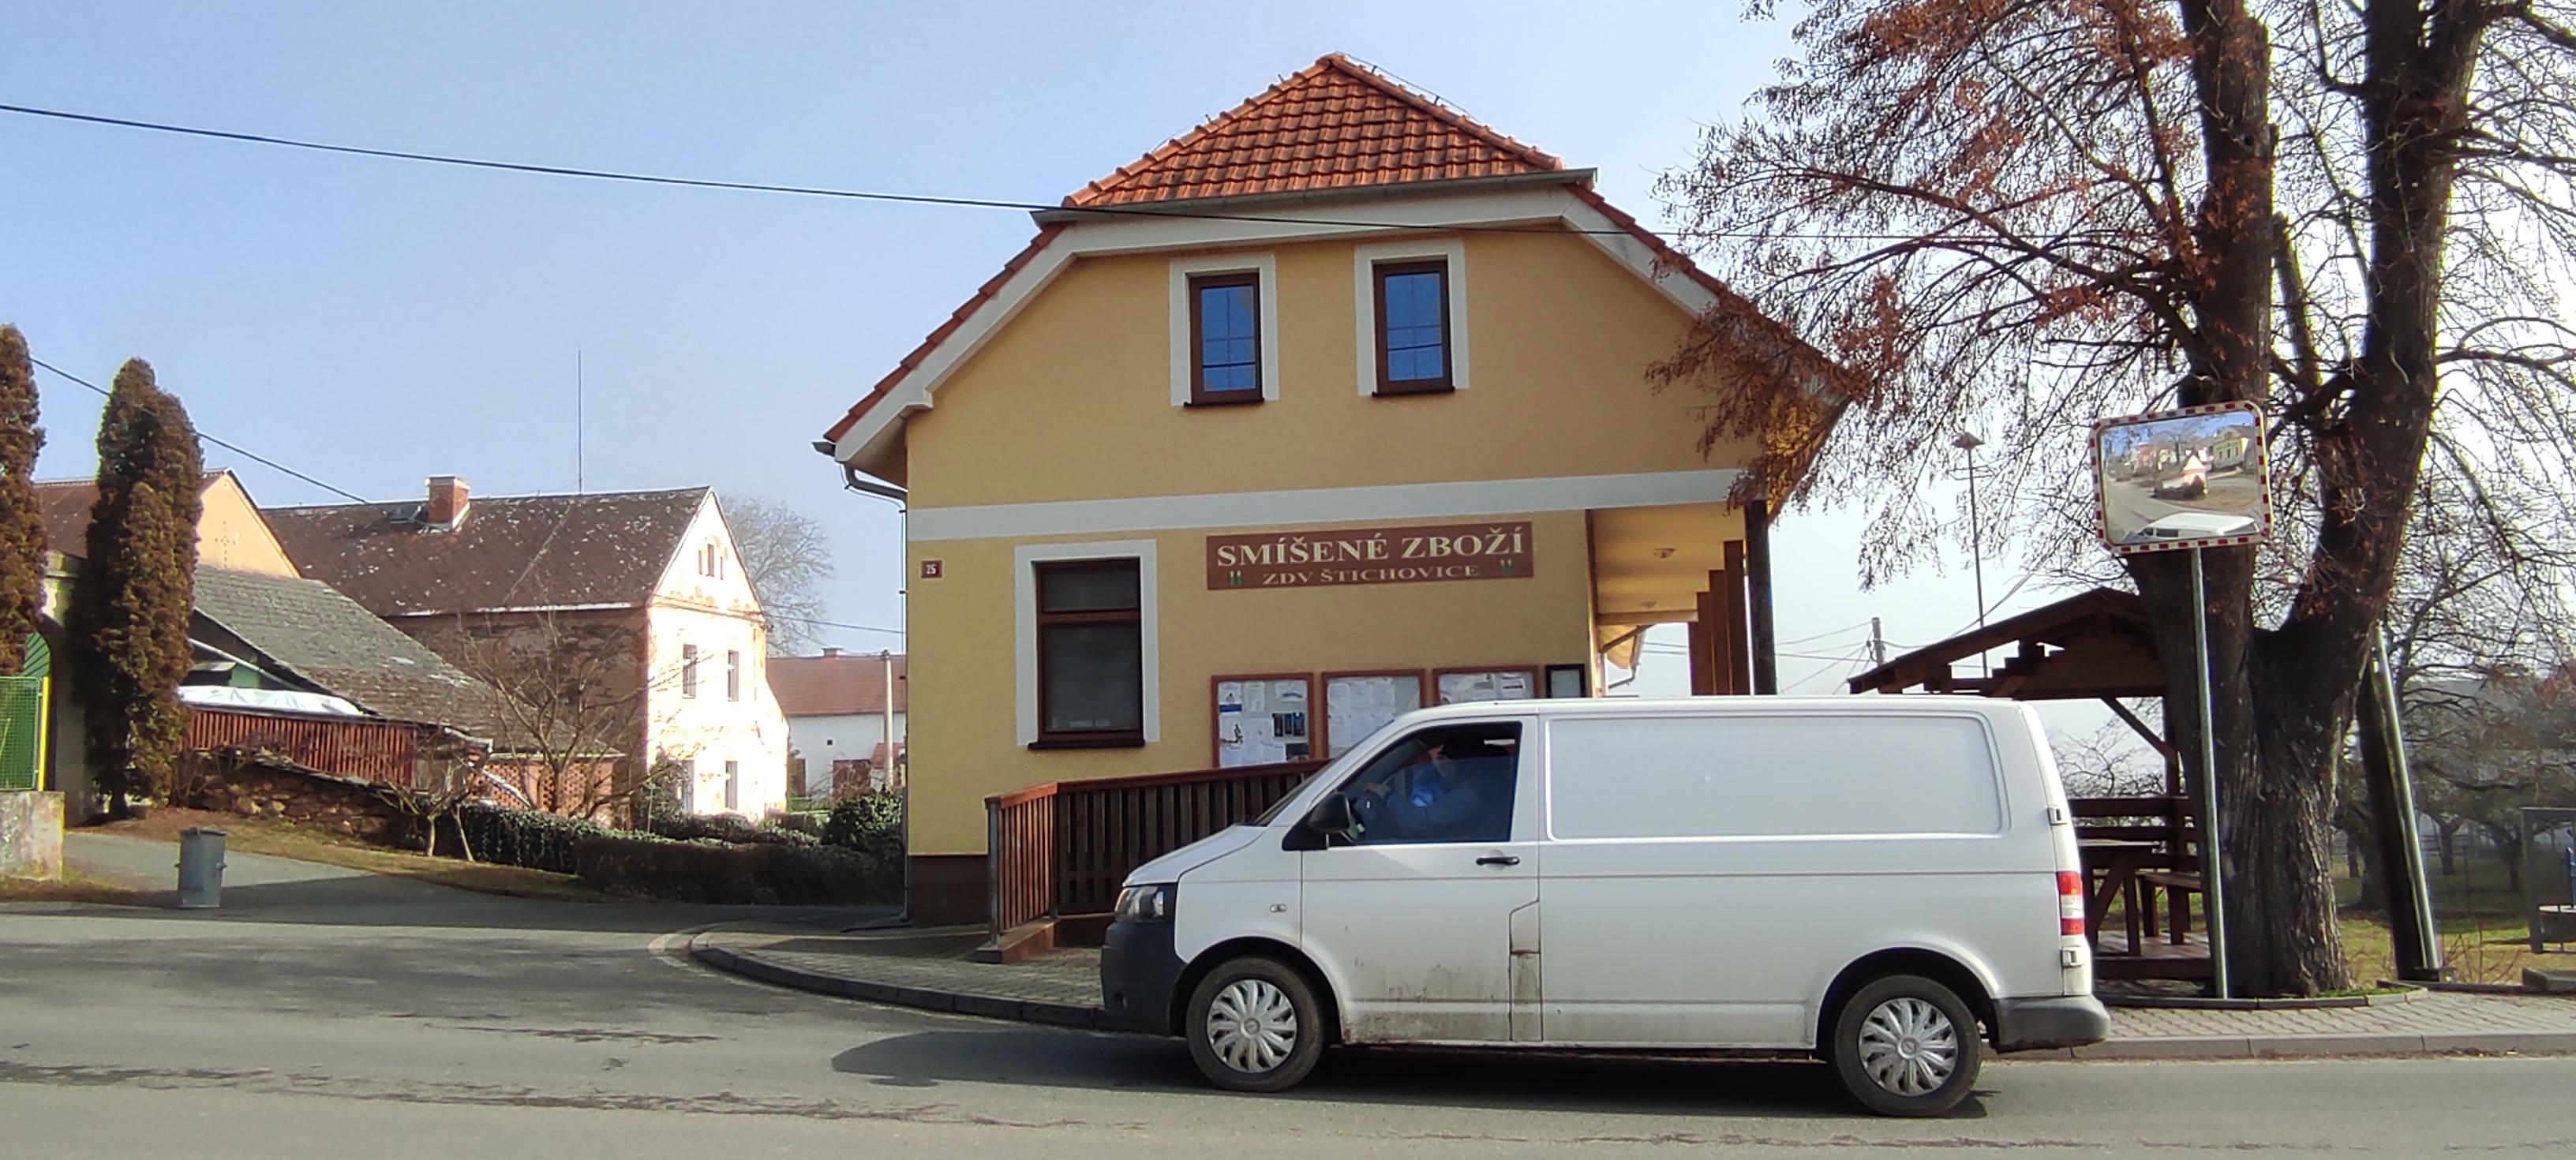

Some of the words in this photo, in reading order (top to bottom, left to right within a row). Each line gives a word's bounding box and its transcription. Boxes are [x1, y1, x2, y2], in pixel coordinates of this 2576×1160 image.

[1218, 533, 1389, 567] SMÍŠENÉ
[1401, 526, 1524, 559] ZBOŽÍ
[1264, 572, 1314, 585] ZDV
[1320, 565, 1480, 583] ŠTICHOVICE
